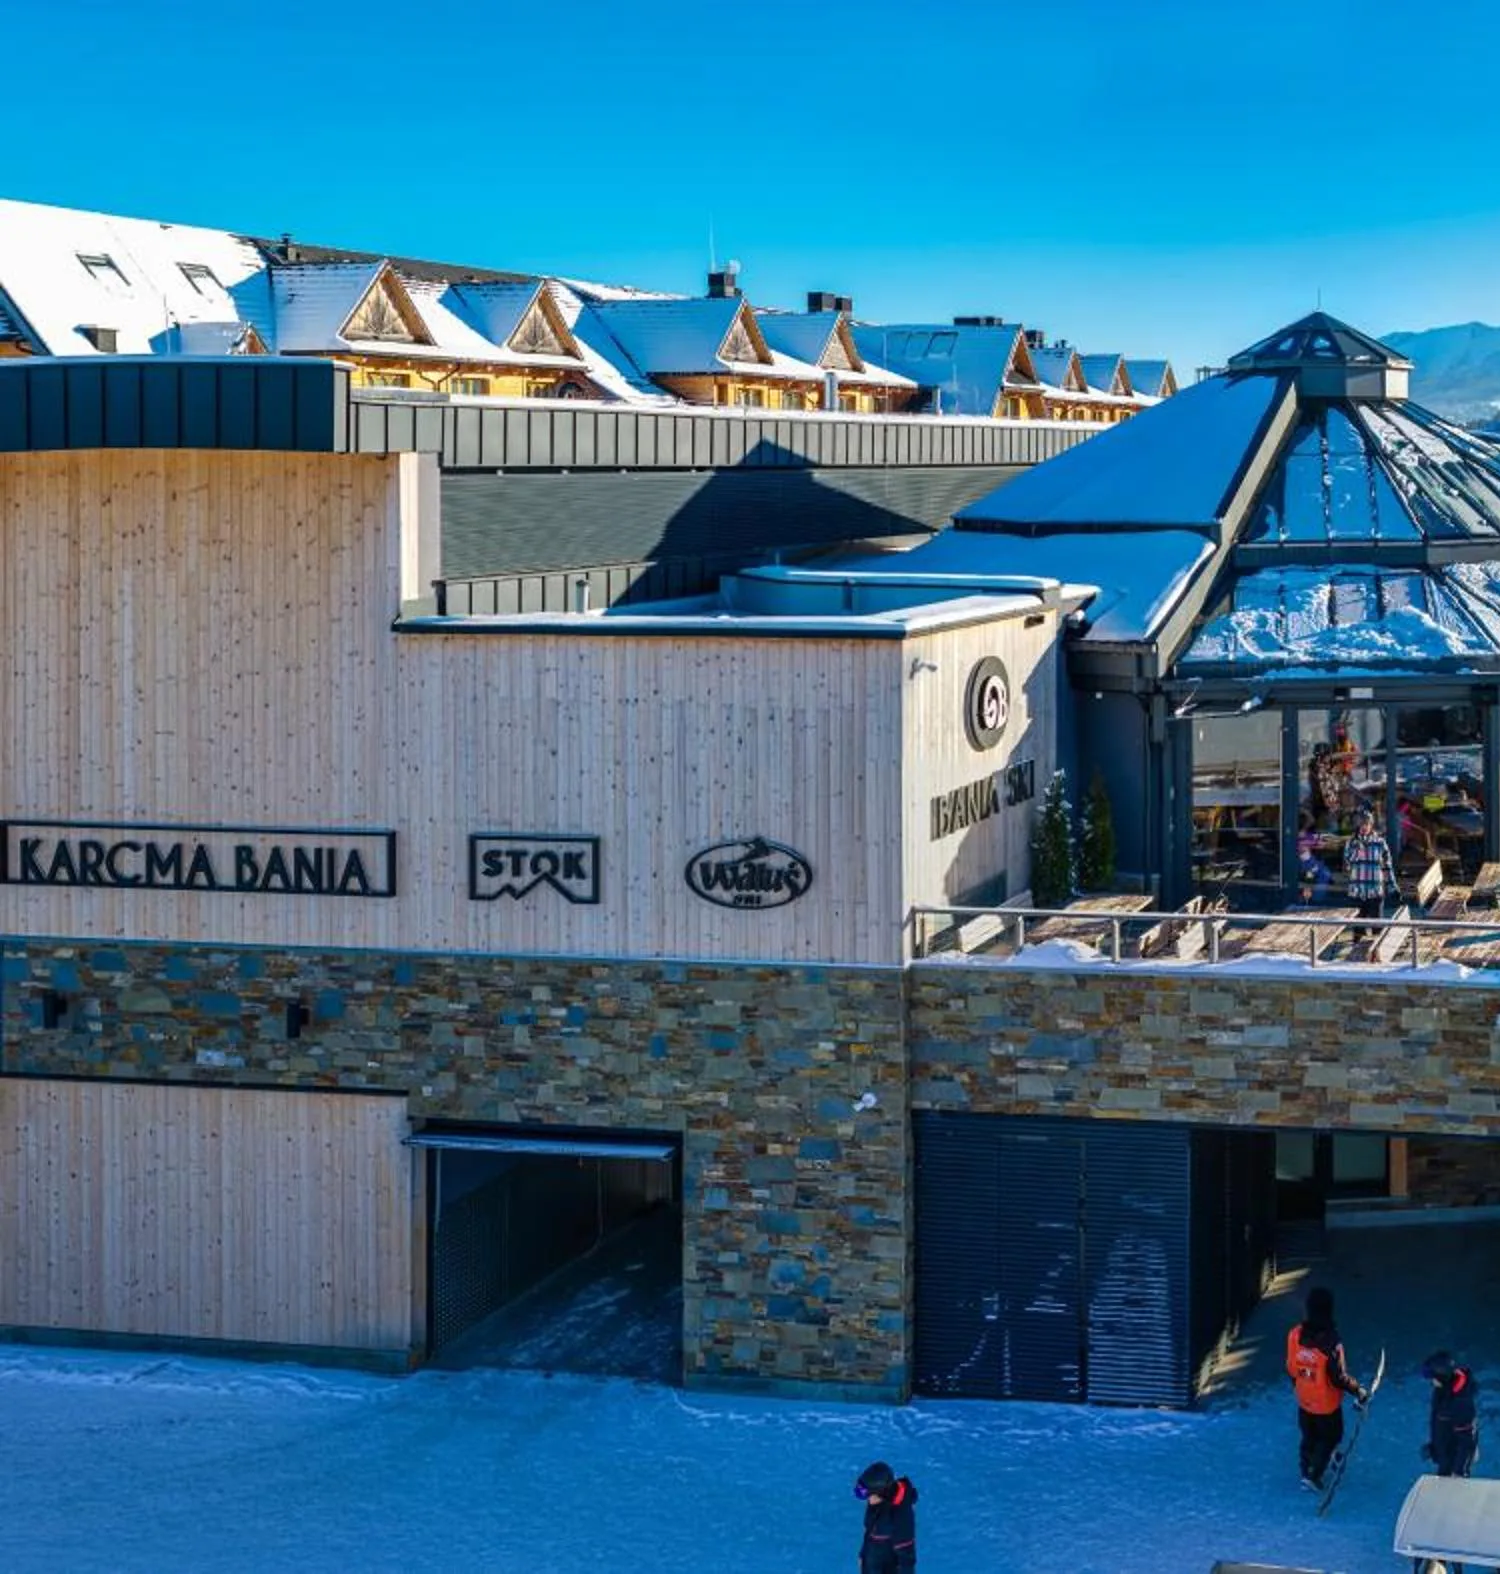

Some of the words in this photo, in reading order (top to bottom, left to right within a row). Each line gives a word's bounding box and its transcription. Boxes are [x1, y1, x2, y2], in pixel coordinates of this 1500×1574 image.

[930, 775, 1000, 842] BANIA
[1004, 760, 1035, 807] SKI
[19, 838, 216, 888] KARCMA
[235, 845, 372, 894] BANIA
[482, 849, 586, 880] STOK
